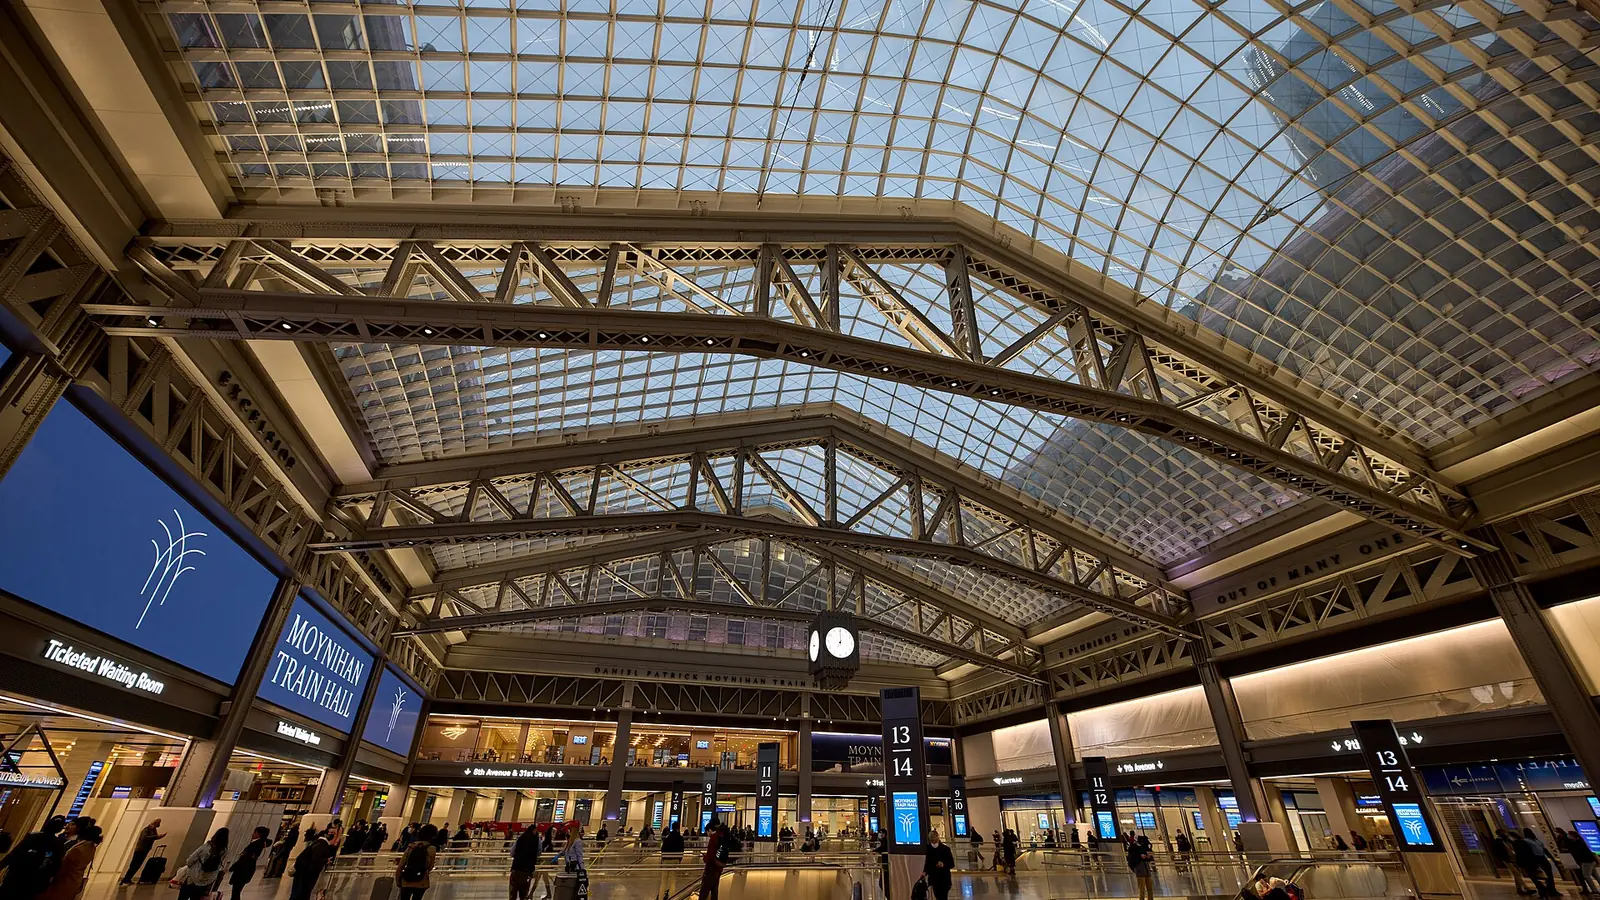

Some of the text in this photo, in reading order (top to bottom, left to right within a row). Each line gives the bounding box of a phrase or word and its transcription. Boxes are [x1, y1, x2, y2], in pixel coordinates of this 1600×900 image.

[218, 370, 296, 472] EXCELSIOR
[1217, 533, 1404, 604] OUT OF MANY ONE
[286, 614, 364, 686] MOYNIHAN
[44, 639, 164, 695] Ticketed Waiting Room
[271, 650, 353, 718] TRAIN HALL
[594, 667, 638, 677] DANIEL
[646, 670, 698, 681] PATRICK
[706, 674, 766, 685] MOYNIHAN
[773, 679, 805, 688] TRAIN
[892, 726, 911, 744] 13
[1376, 750, 1398, 766] 13
[485, 768, 511, 777] Avenue
[518, 769, 534, 778] 31st
[533, 770, 556, 778] Street
[762, 766, 771, 777] 11
[892, 757, 914, 777] 14
[706, 783, 712, 792] 9
[1093, 777, 1103, 788] 11
[1385, 776, 1408, 792] 14
[761, 785, 772, 797] 12
[1096, 793, 1108, 804] 12
[704, 797, 712, 806] 10
[954, 802, 963, 810] 10
